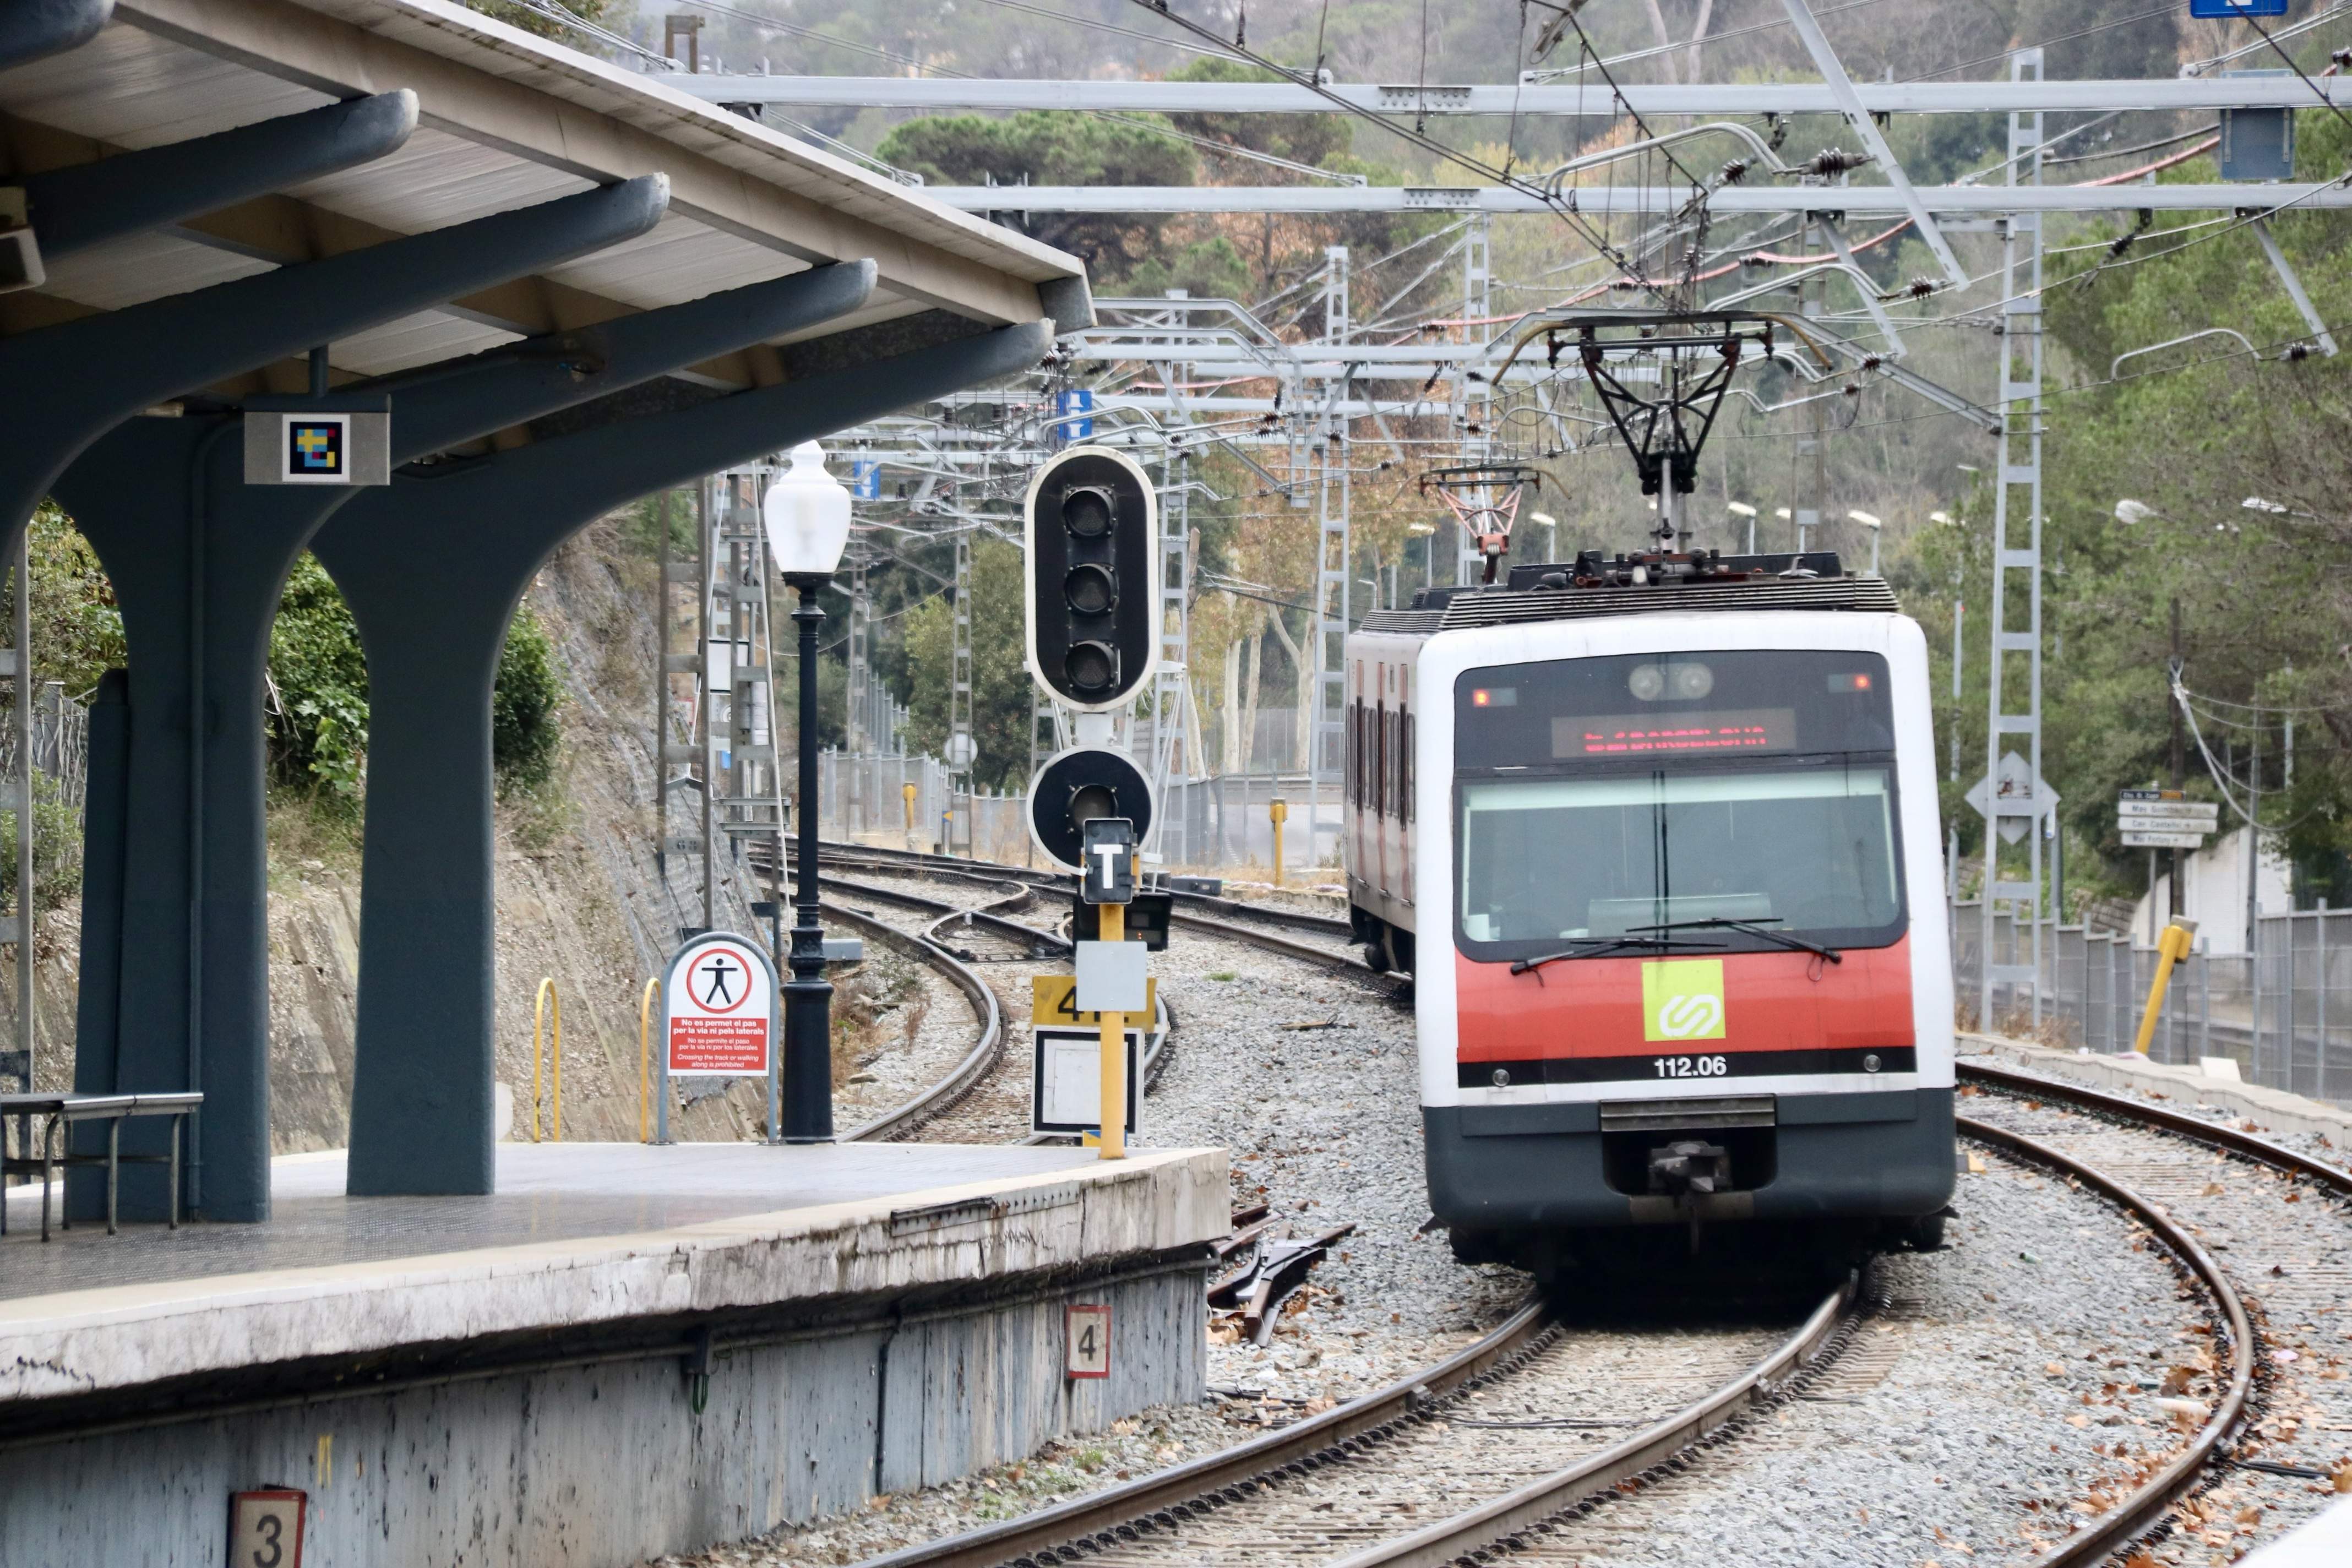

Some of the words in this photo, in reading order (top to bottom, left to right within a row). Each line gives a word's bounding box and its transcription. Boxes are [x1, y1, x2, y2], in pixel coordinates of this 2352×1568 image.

[1093, 844, 1123, 889] T
[718, 1027, 734, 1036] pels
[1654, 1055, 1727, 1077] 112.06
[1078, 1325, 1097, 1362] 4
[253, 1515, 282, 1568] 3
